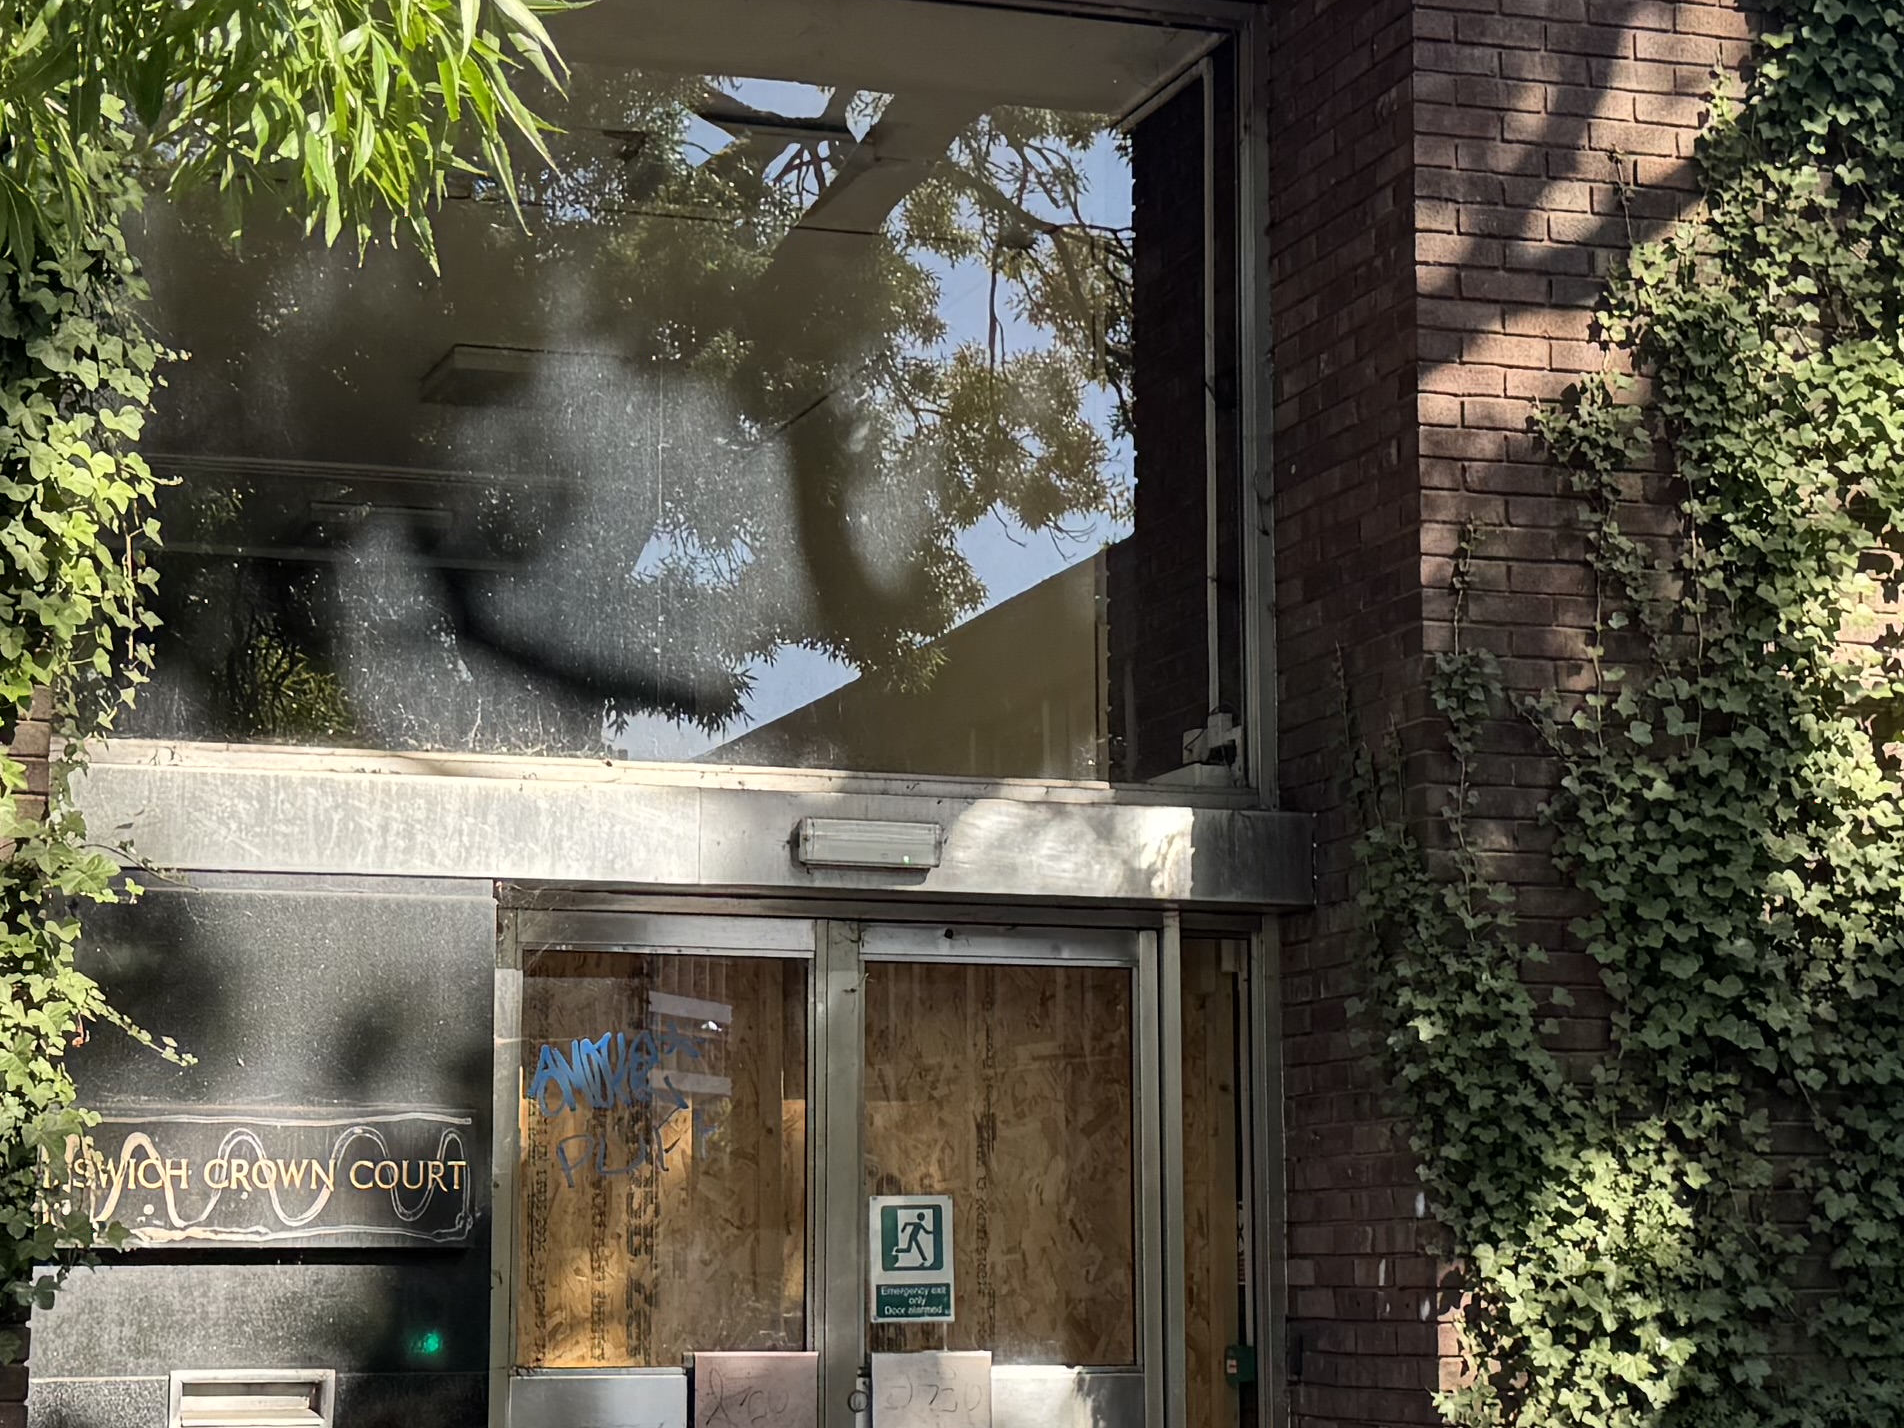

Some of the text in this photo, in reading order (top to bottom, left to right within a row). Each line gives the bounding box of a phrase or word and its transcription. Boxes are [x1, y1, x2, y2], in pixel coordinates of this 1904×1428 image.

[203, 1158, 335, 1192] CROWN
[349, 1159, 467, 1192] COURT
[881, 1286, 947, 1297] Emergency exit
[908, 1296, 927, 1306] only
[884, 1305, 943, 1316] Door alarmed
